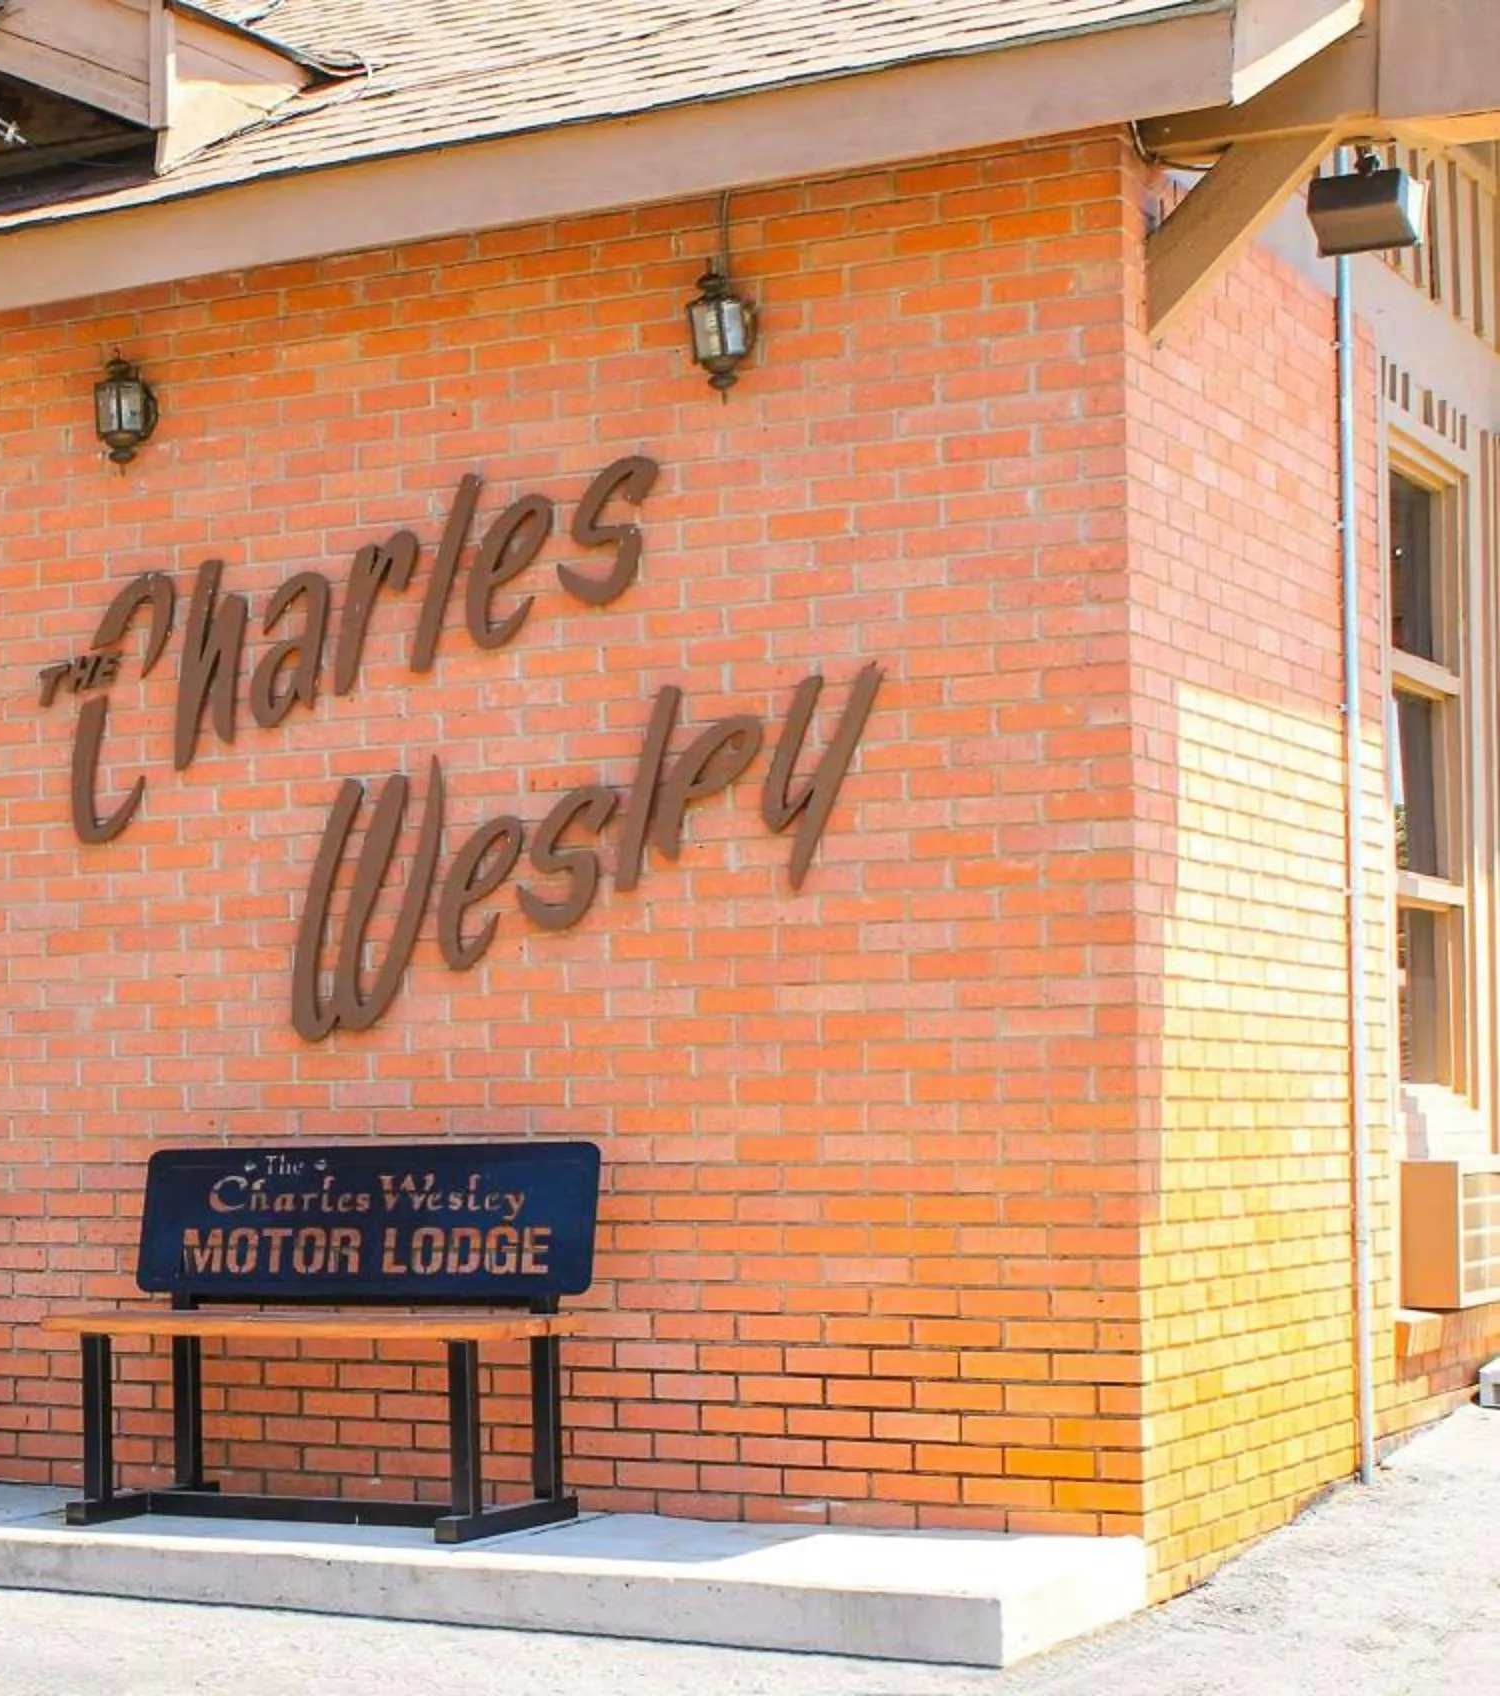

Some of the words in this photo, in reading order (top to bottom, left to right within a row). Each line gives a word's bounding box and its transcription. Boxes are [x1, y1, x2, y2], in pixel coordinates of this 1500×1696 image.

[71, 454, 660, 845] Charles
[39, 651, 122, 708] THE
[291, 659, 887, 1043] Wesley
[265, 1154, 305, 1176] The
[208, 1174, 371, 1214] Charles
[378, 1172, 526, 1222] Wesley
[183, 1226, 362, 1275] MOTOR
[381, 1226, 552, 1275] LODGE
